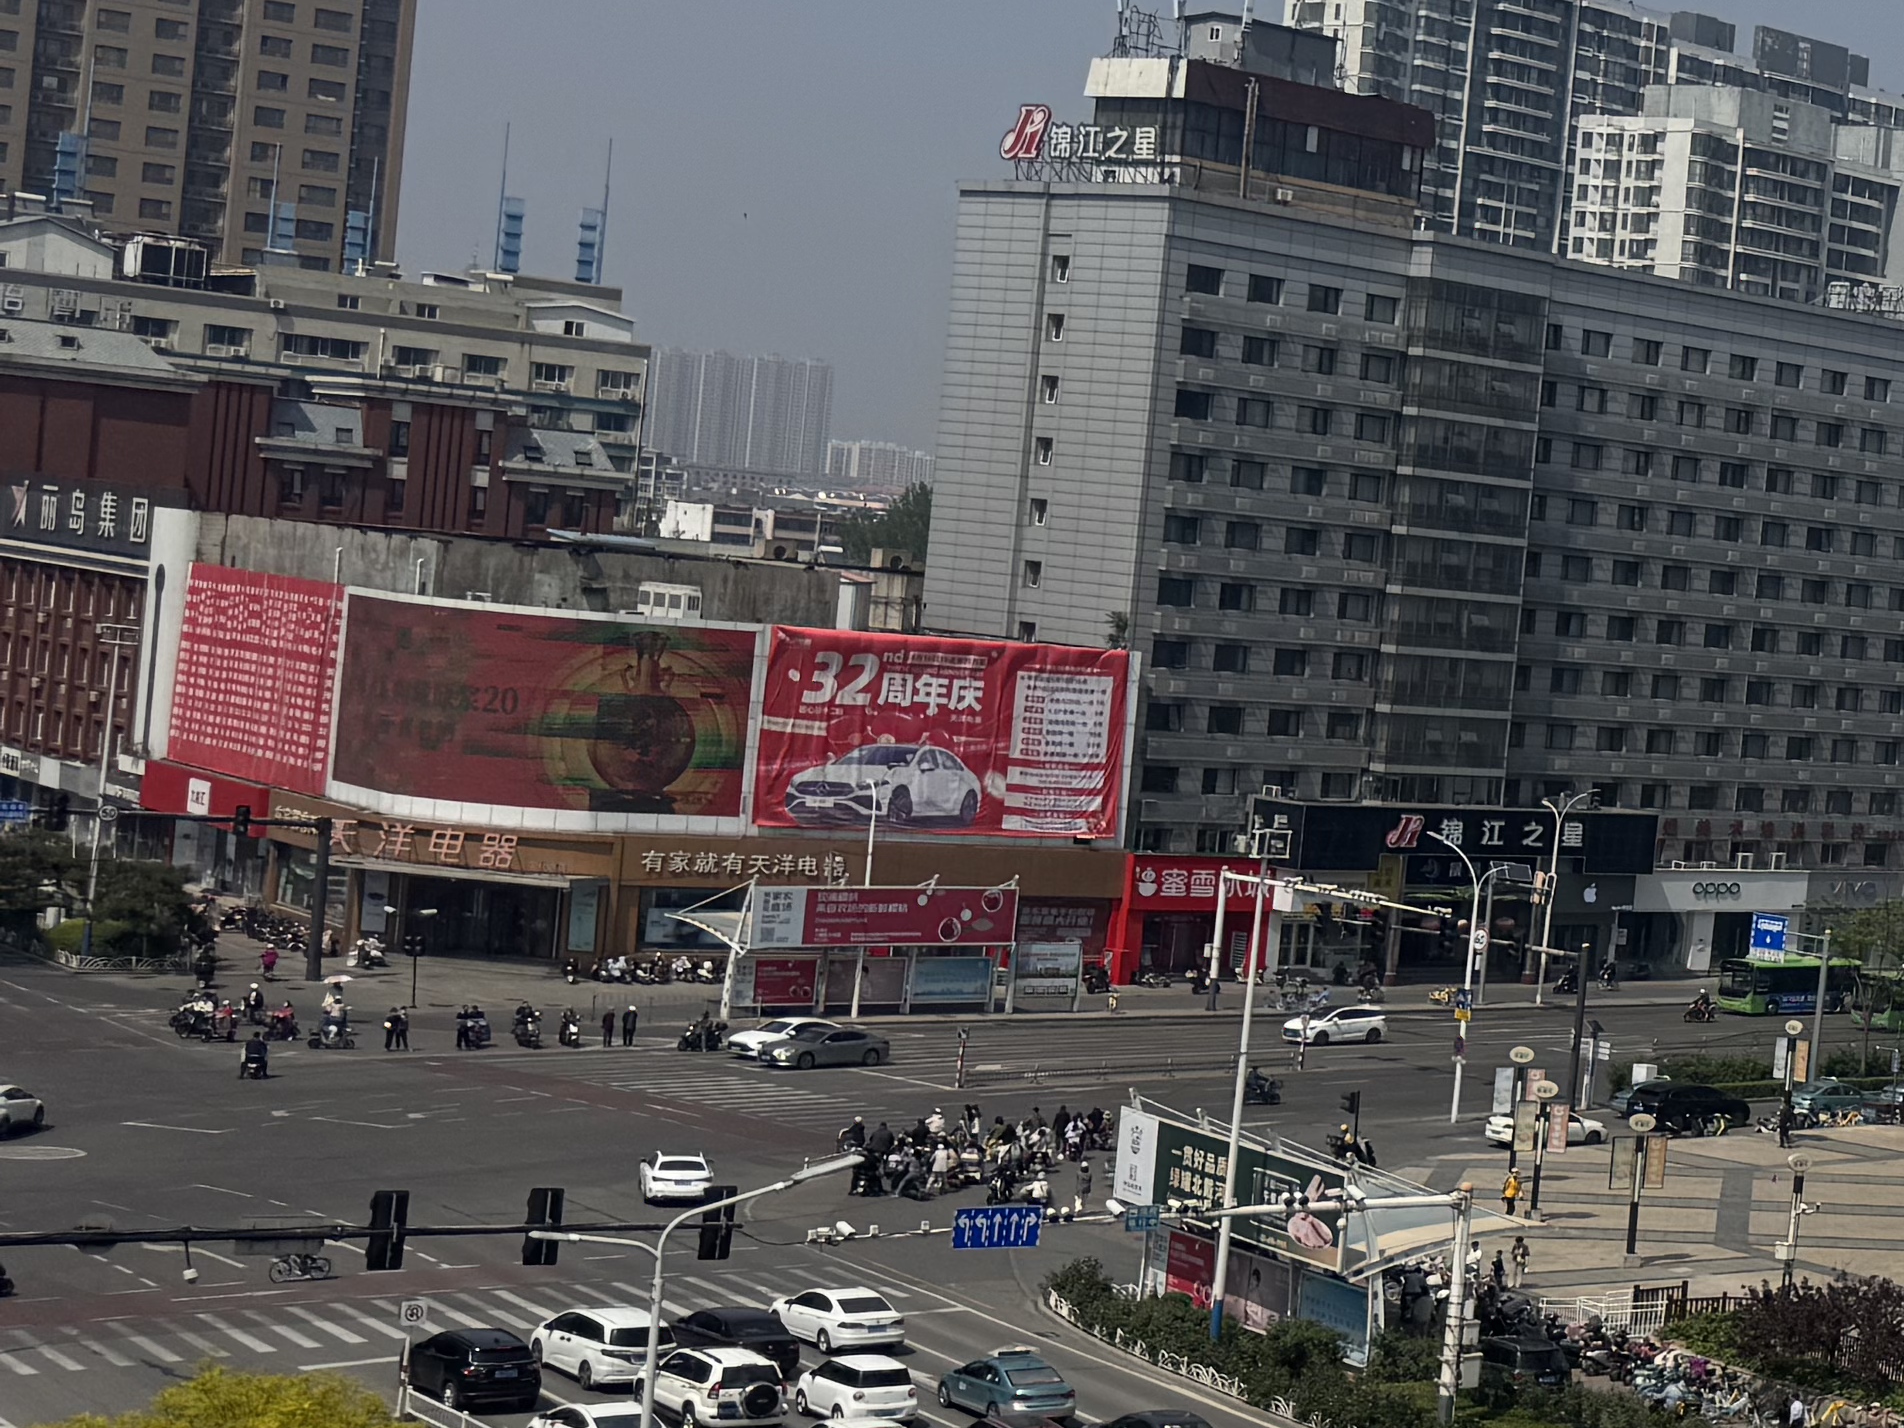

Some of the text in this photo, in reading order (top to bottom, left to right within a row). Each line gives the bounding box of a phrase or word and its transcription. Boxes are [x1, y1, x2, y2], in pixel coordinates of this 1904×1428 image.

[1049, 123, 1159, 163] 锦江之星
[40, 483, 150, 545] 丽岛集团
[877, 671, 986, 714] 周年庆
[1439, 817, 1585, 848] 锦江之星
